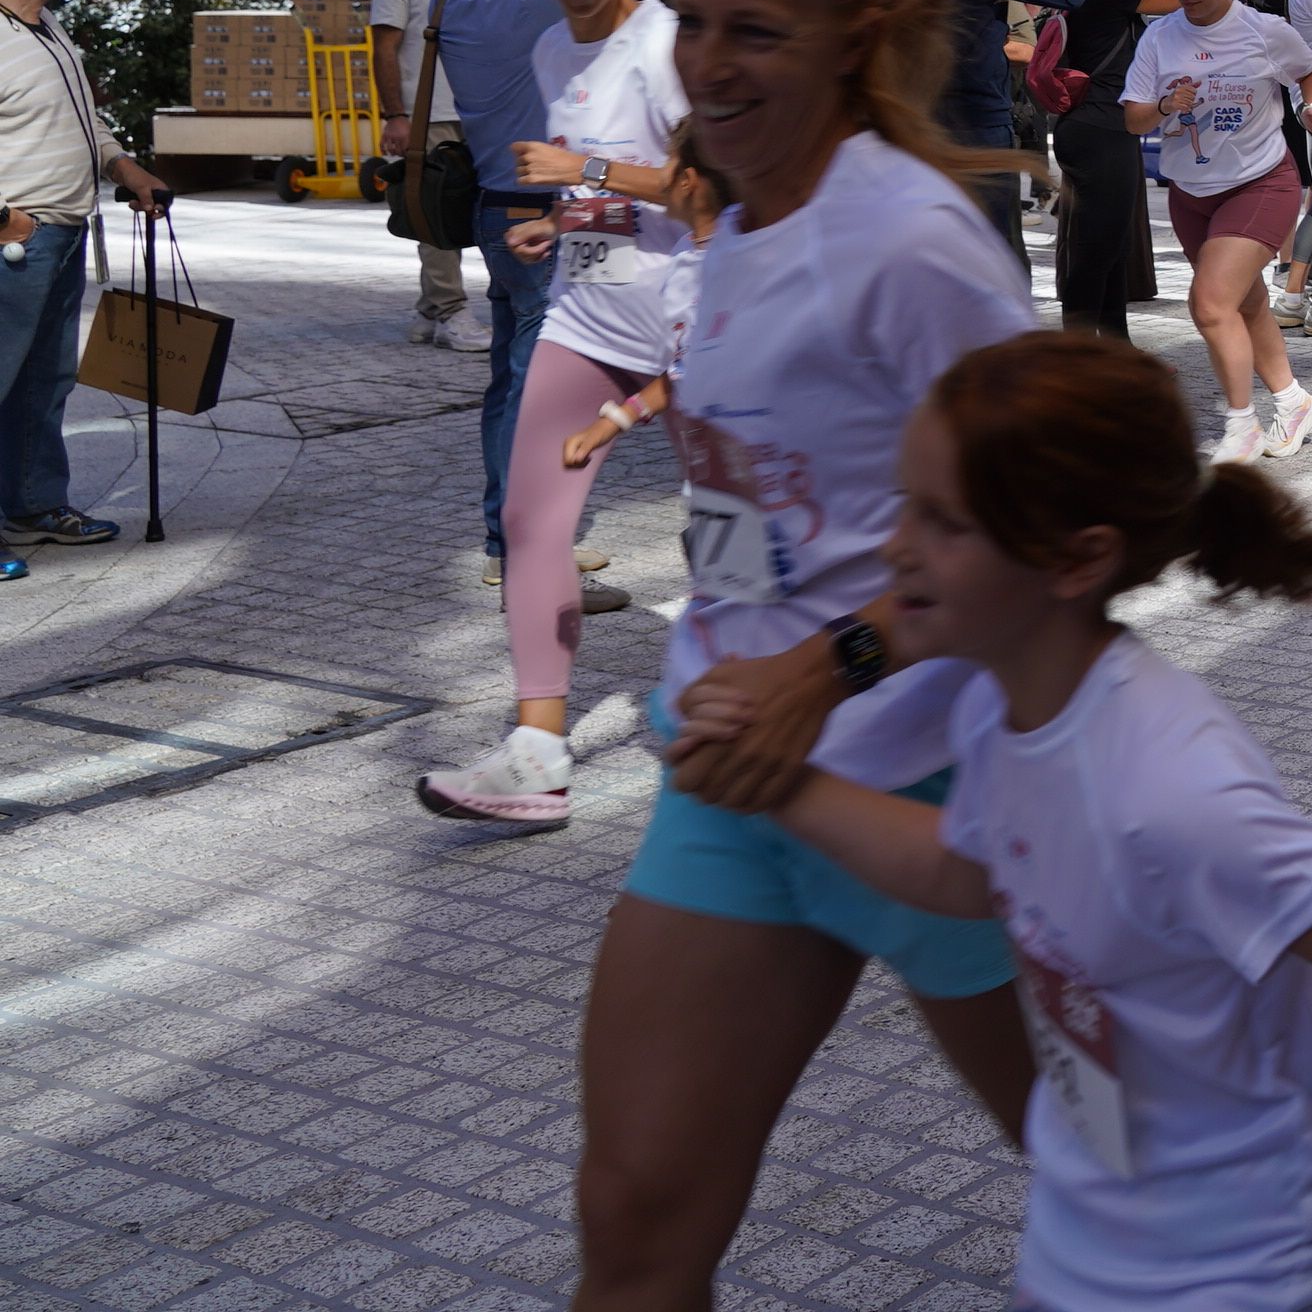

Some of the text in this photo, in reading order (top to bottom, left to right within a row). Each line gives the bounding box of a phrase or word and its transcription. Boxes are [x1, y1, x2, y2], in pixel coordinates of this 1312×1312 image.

[1216, 107, 1242, 115] CADA
[1214, 115, 1242, 123] PAS
[569, 241, 608, 268] 790
